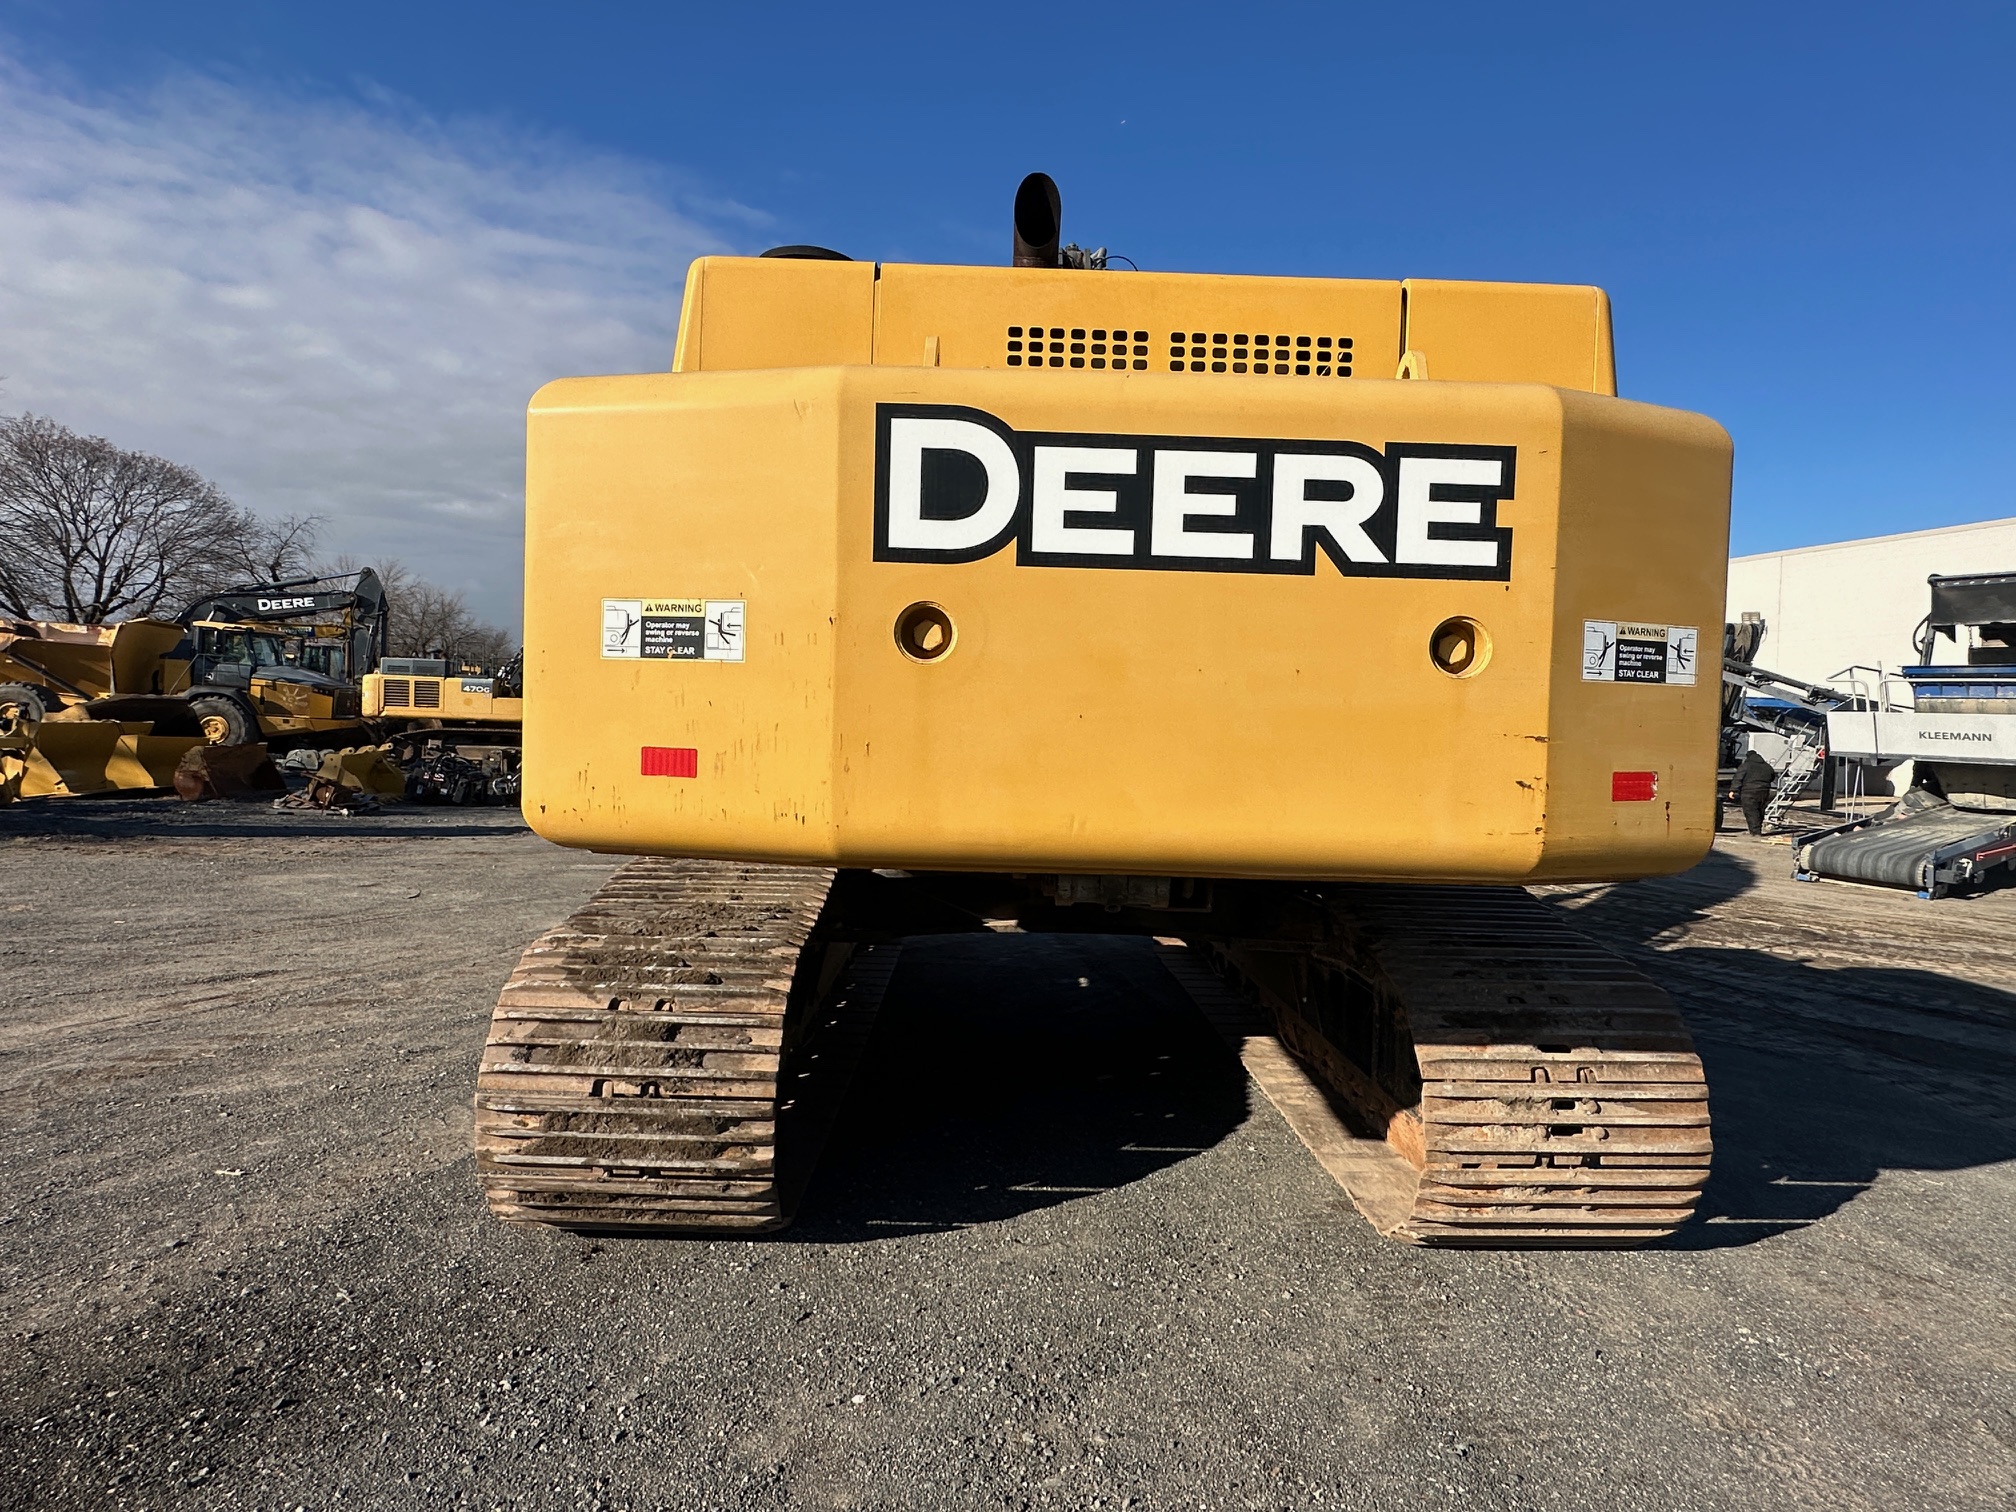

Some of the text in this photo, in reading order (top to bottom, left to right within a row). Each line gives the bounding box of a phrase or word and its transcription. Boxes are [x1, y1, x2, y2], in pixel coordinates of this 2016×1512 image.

[887, 417, 1503, 566] DEERE
[257, 597, 315, 611] DEERE
[655, 603, 702, 613] WARNING
[645, 621, 690, 630] Operator may
[645, 629, 666, 638] swing
[1627, 626, 1666, 637] WARNING
[645, 635, 673, 643] machine
[645, 646, 666, 654] STAY
[1619, 644, 1644, 652] Operator
[1619, 653, 1636, 661] swing
[1618, 669, 1659, 679] STAY CLEAR
[462, 685, 491, 693] 470G
[1918, 731, 1992, 742] KLEEMANN
